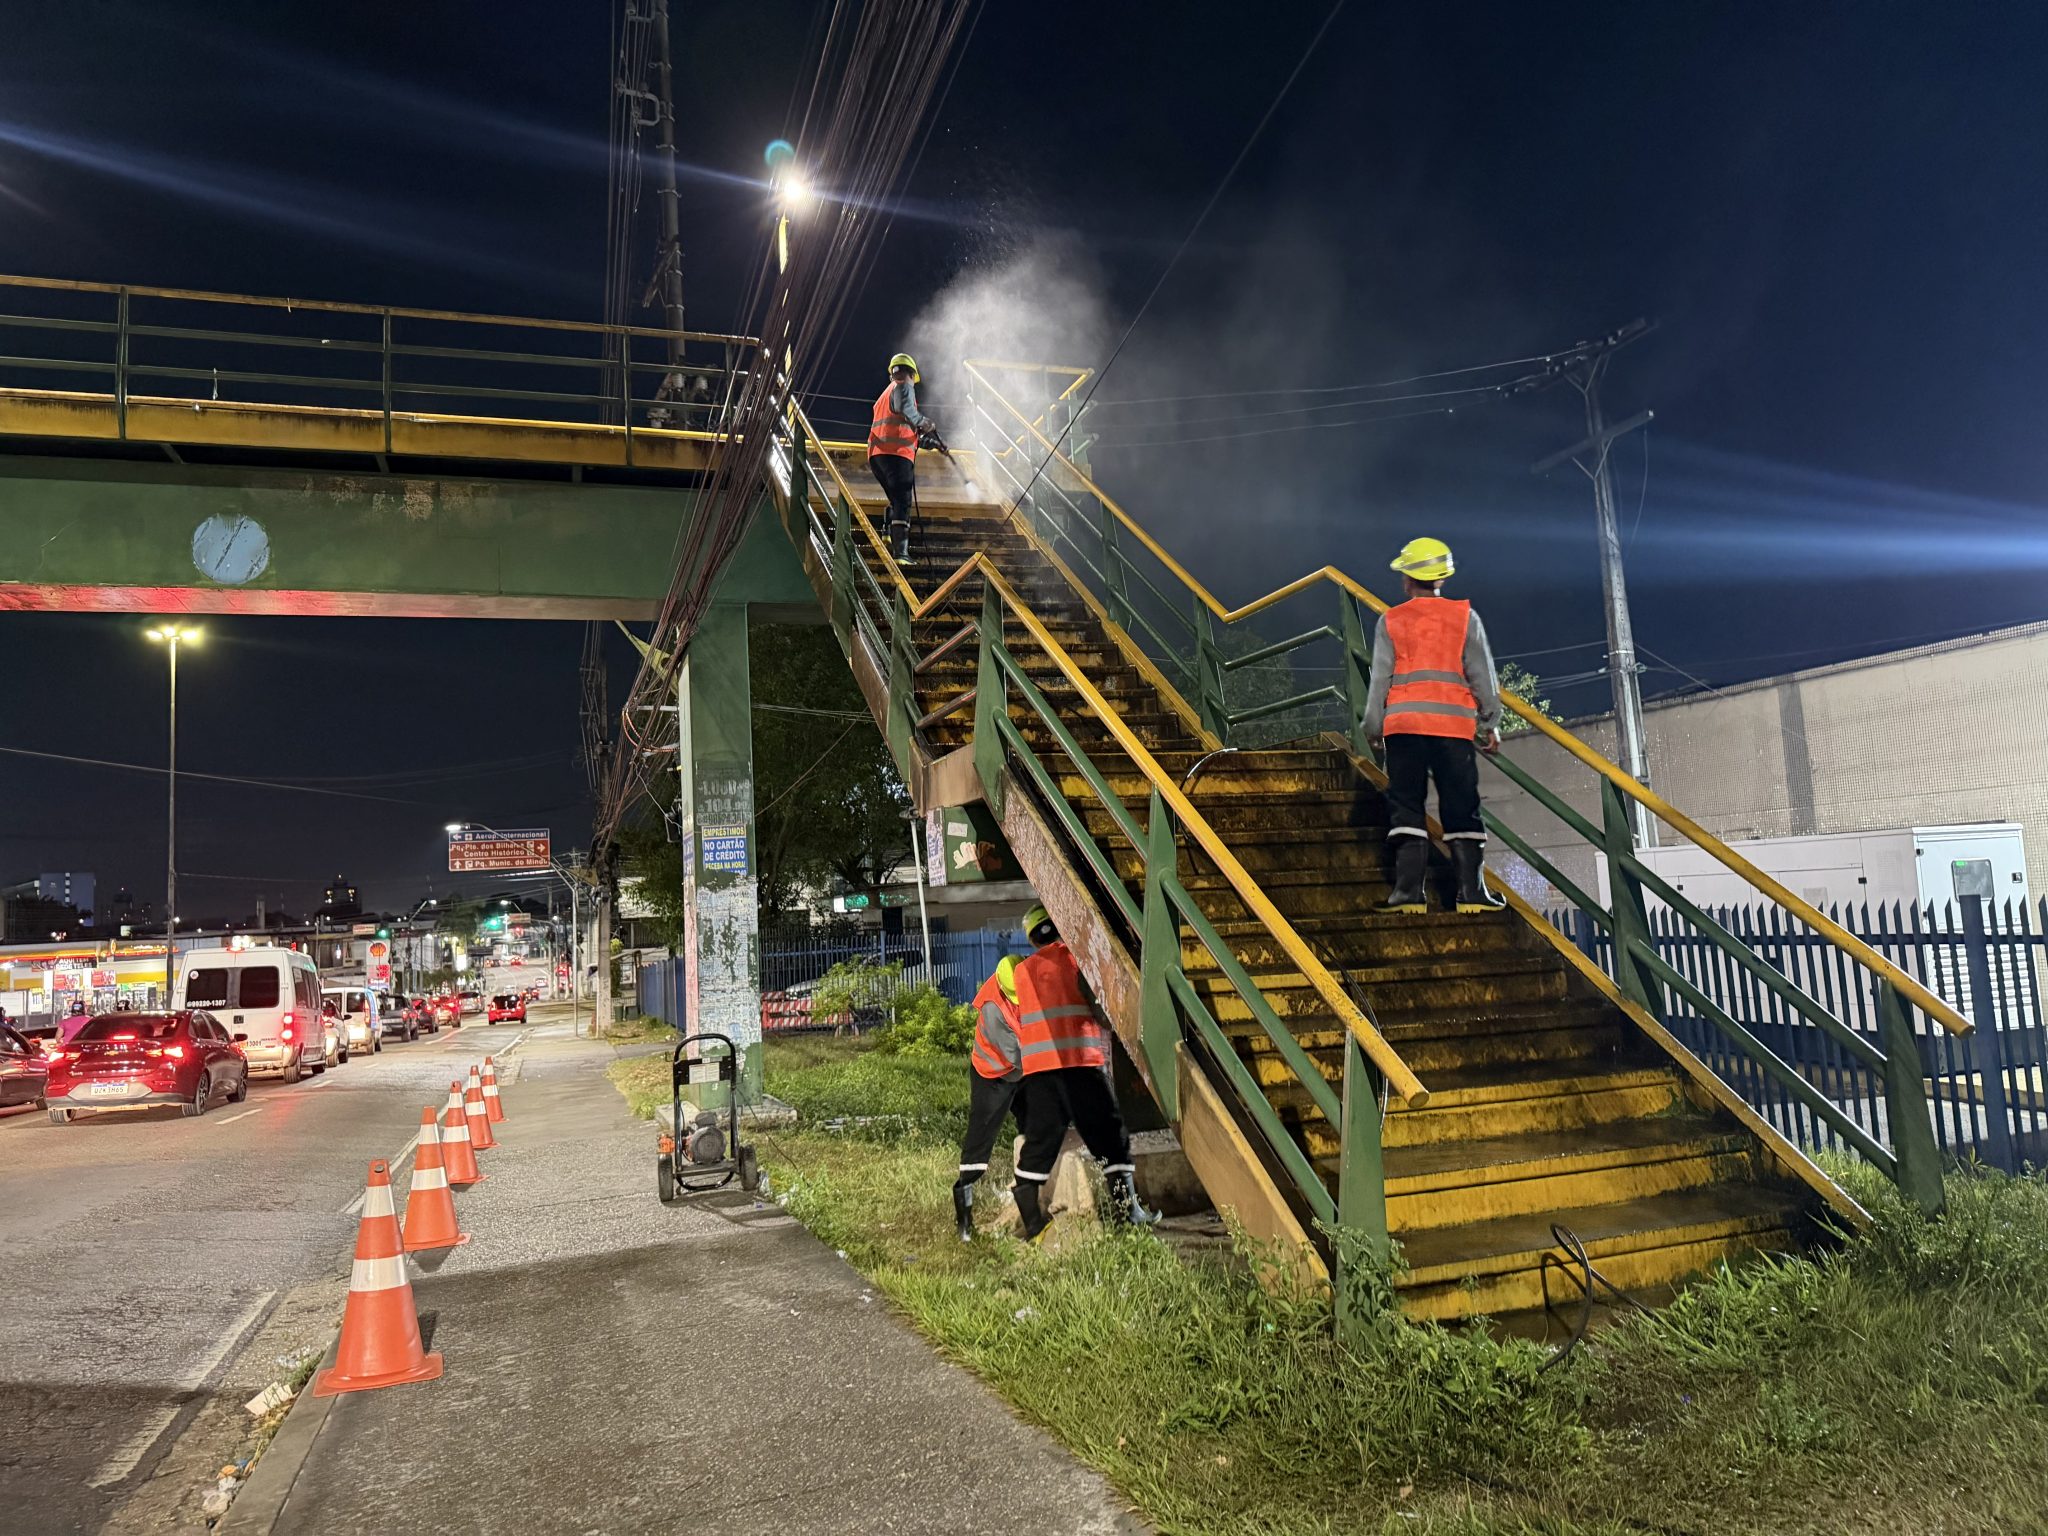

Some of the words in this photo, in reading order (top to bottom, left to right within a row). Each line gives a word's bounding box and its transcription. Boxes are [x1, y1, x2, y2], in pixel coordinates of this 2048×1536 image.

[475, 832, 499, 841] Aerop.
[704, 841, 715, 851] NO
[716, 838, 745, 850] CARTÃO
[491, 849, 525, 857] Histórico
[704, 851, 714, 861] DE
[715, 849, 746, 861] CRÉDITO
[489, 859, 513, 867] Munic.
